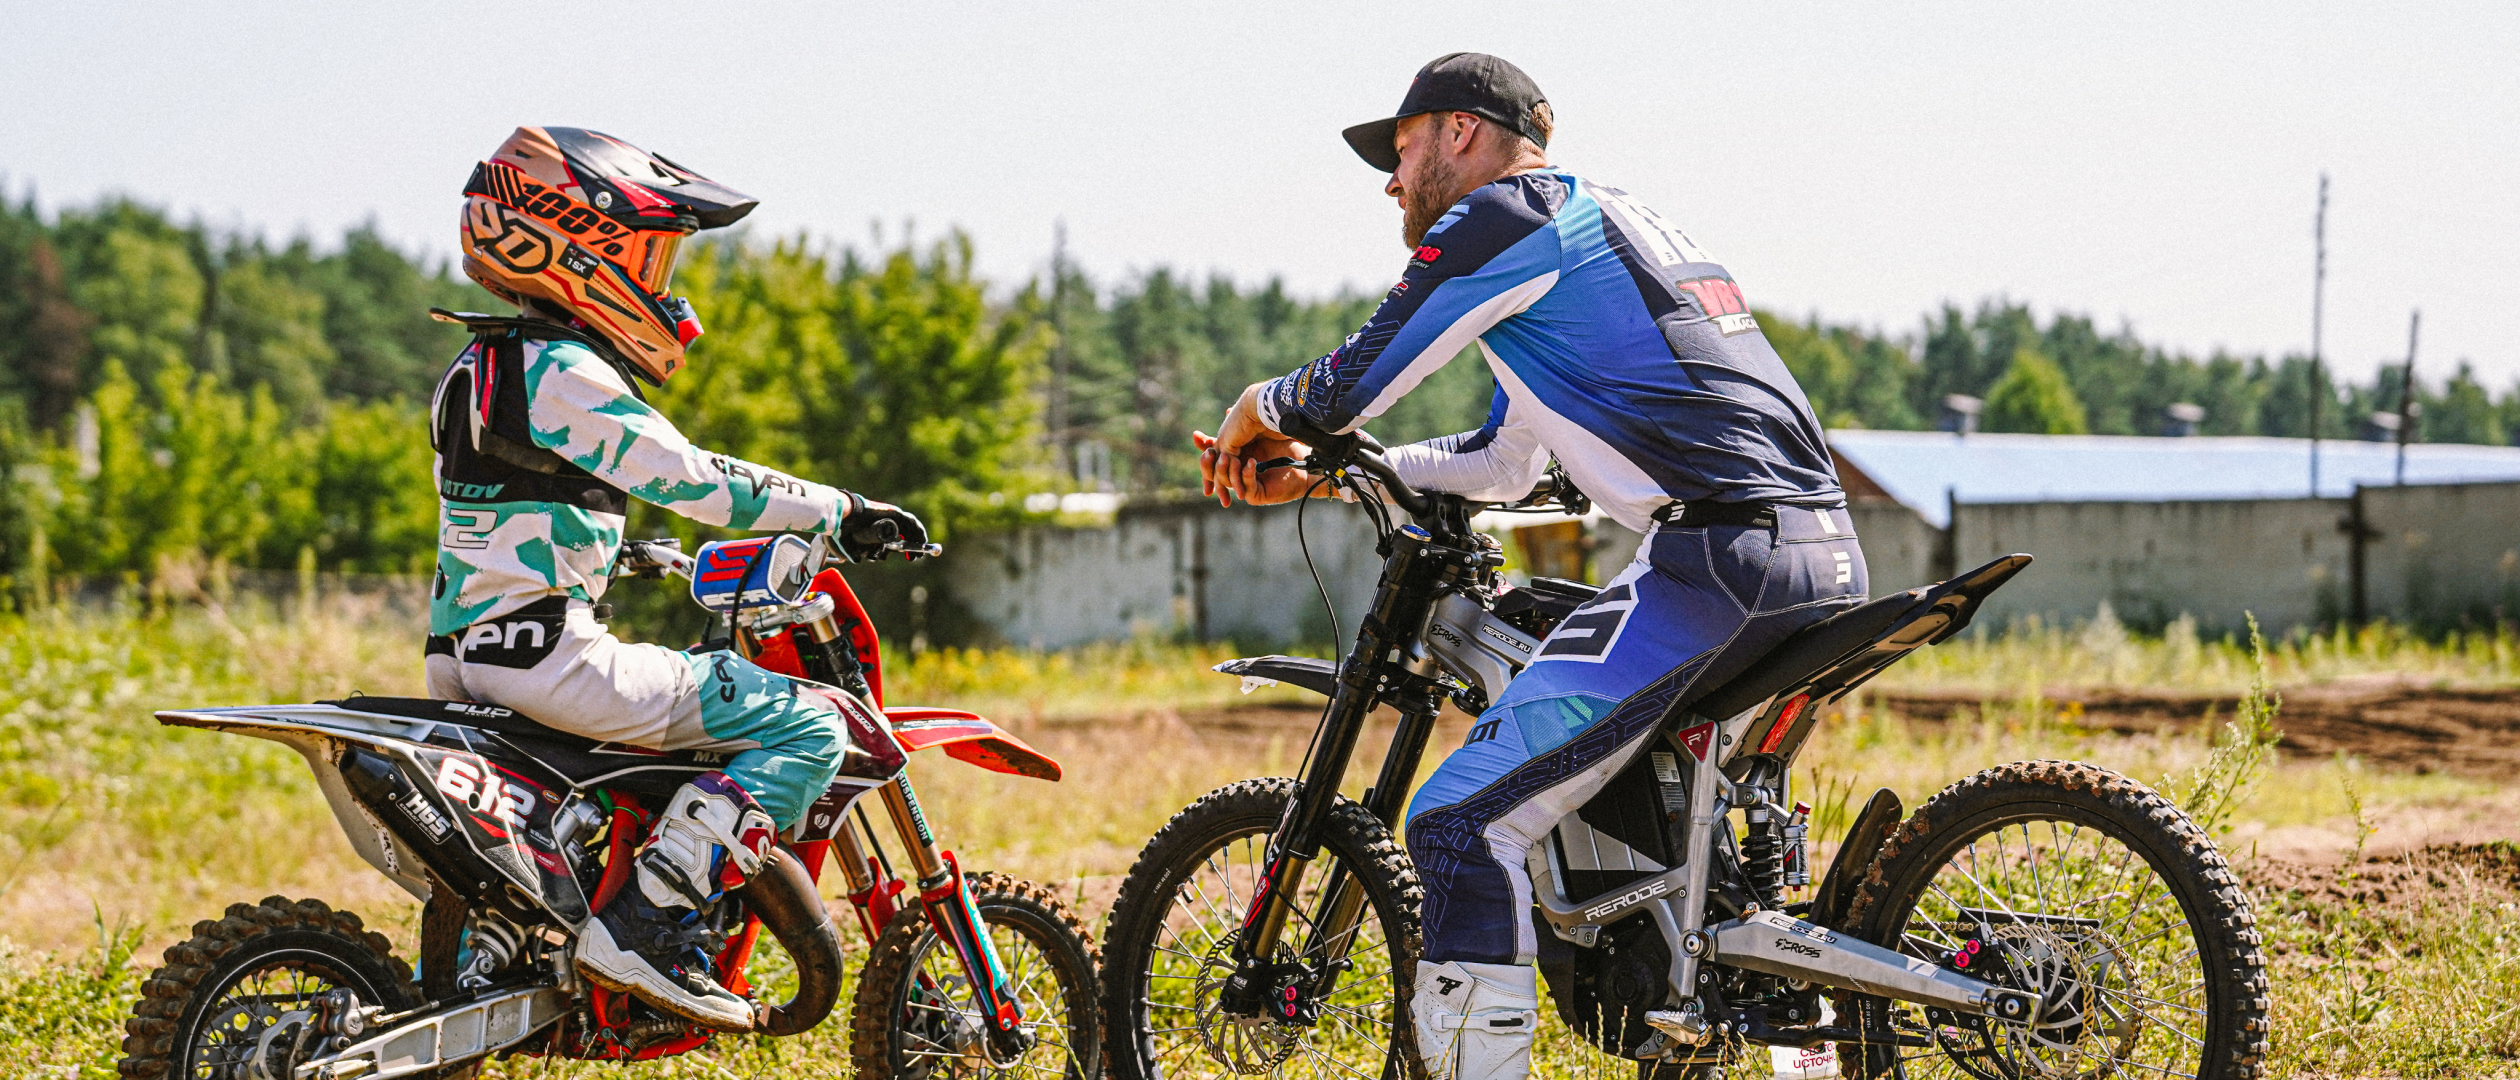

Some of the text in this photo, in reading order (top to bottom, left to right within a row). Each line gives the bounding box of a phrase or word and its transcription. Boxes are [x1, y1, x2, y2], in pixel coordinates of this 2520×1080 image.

[511, 182, 631, 257] 100%
[405, 792, 452, 837] HGS
[436, 755, 537, 831] 612
[900, 770, 929, 841] SUSPENSION
[1585, 879, 1668, 922] RERODE
